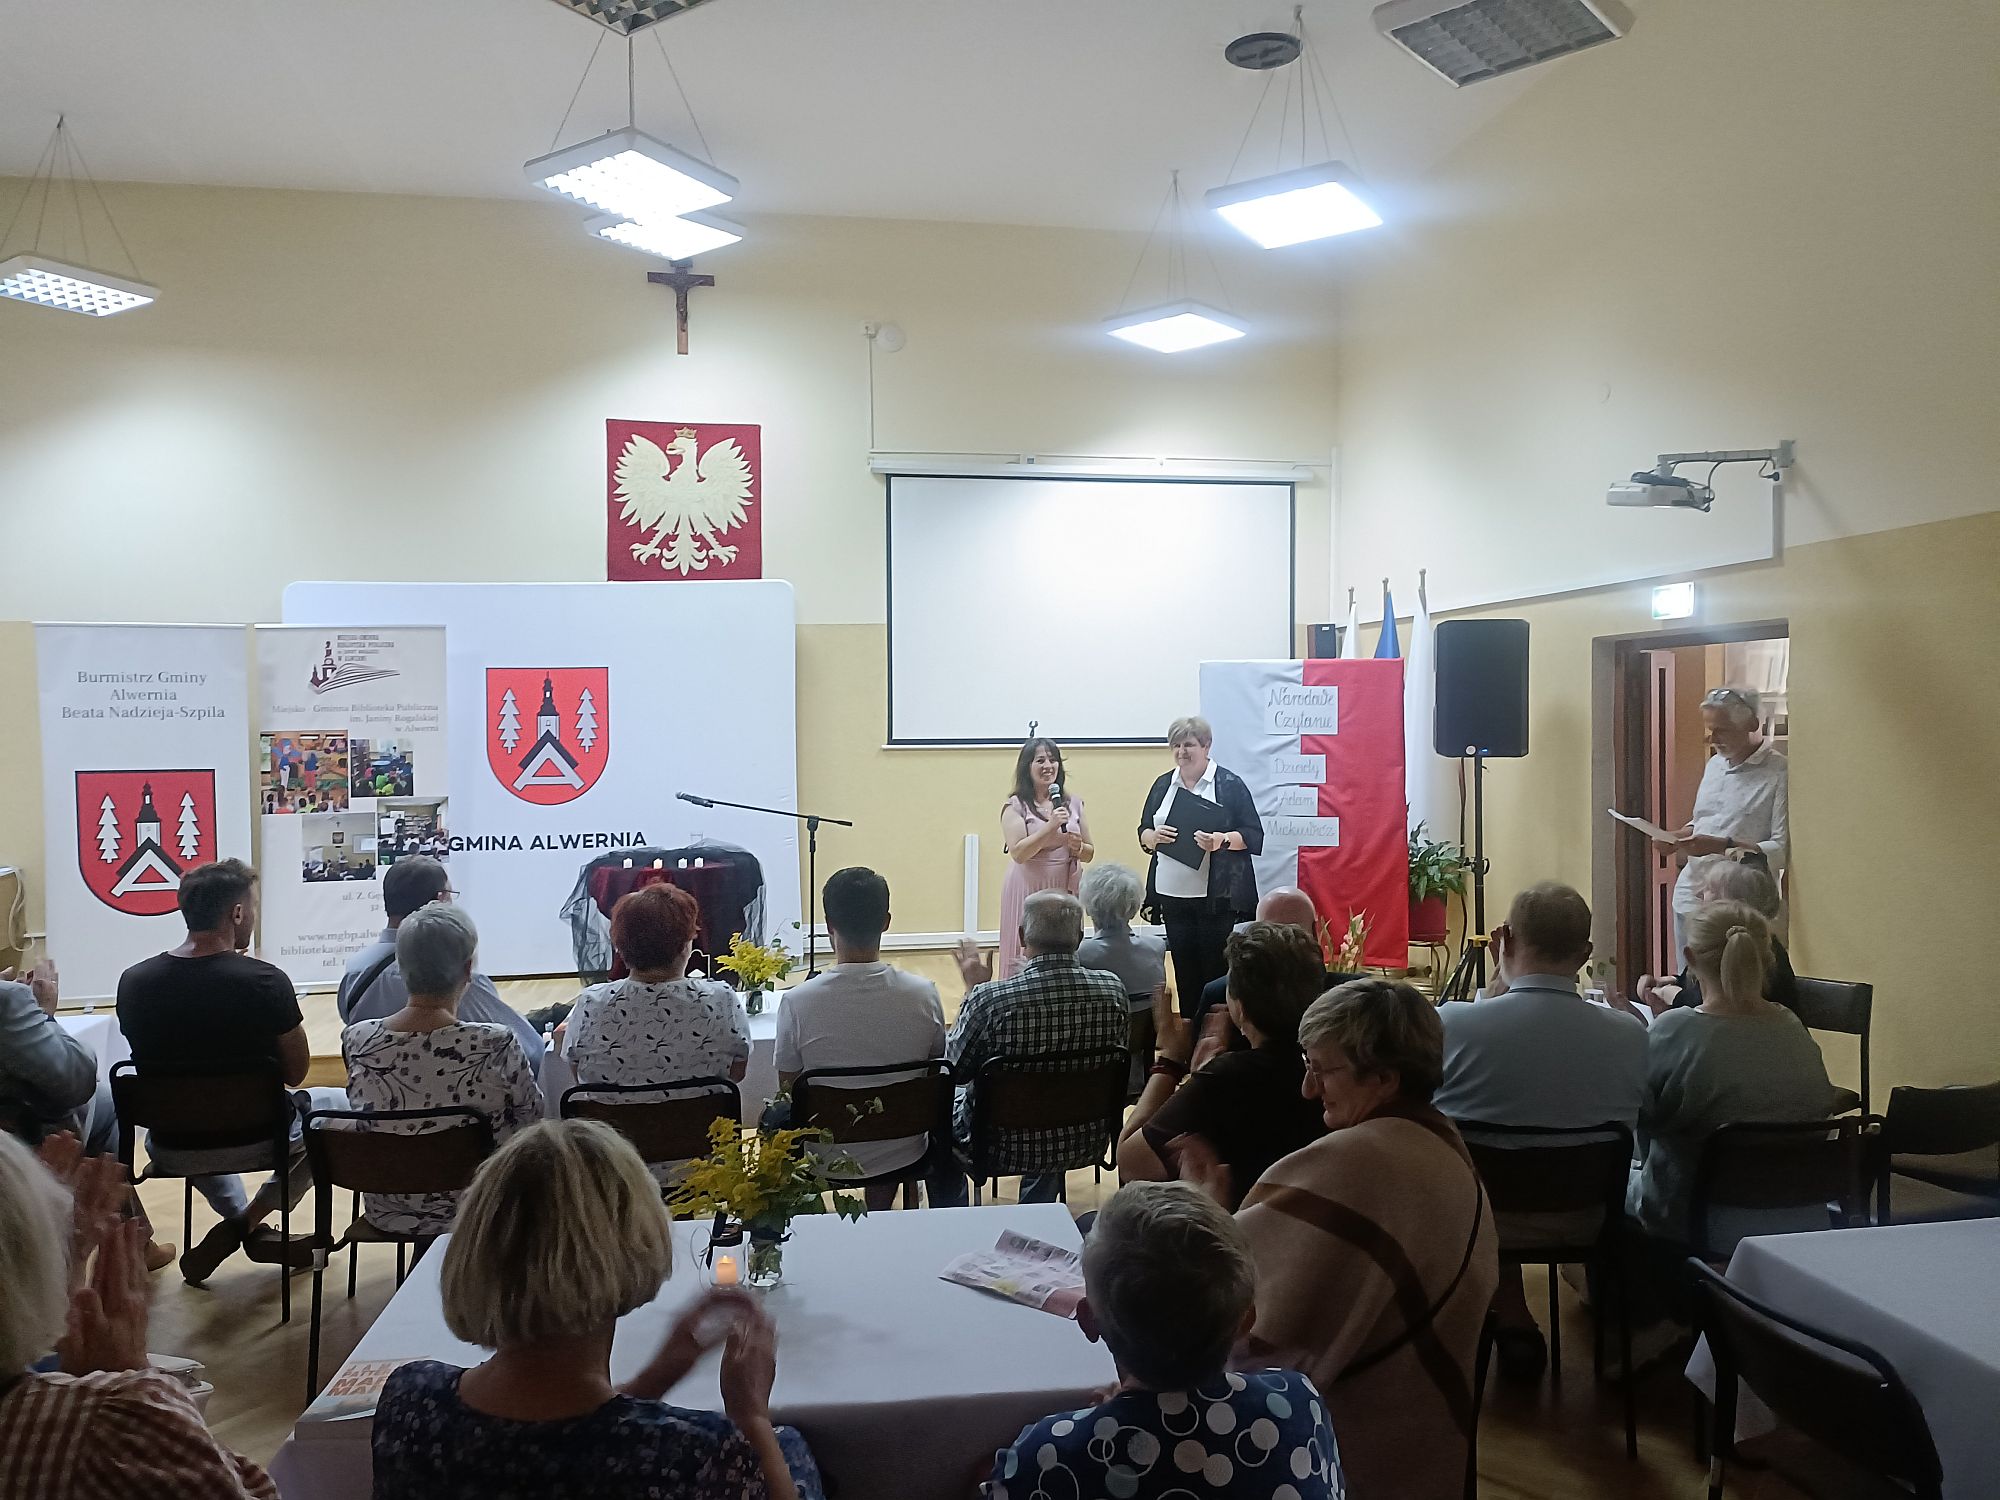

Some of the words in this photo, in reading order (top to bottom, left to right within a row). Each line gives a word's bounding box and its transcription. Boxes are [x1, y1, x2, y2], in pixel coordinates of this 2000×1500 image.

[77, 671, 153, 683] Burmistrz
[158, 671, 207, 686] Gminy
[110, 689, 177, 701] Alwernia
[62, 706, 104, 719] Beata
[109, 706, 225, 721] Nadzieja-Szpila
[351, 703, 395, 712] Biblioteka
[396, 703, 438, 711] Publiczna
[449, 835, 524, 851] GMINA
[529, 831, 647, 850] ALWERNIA
